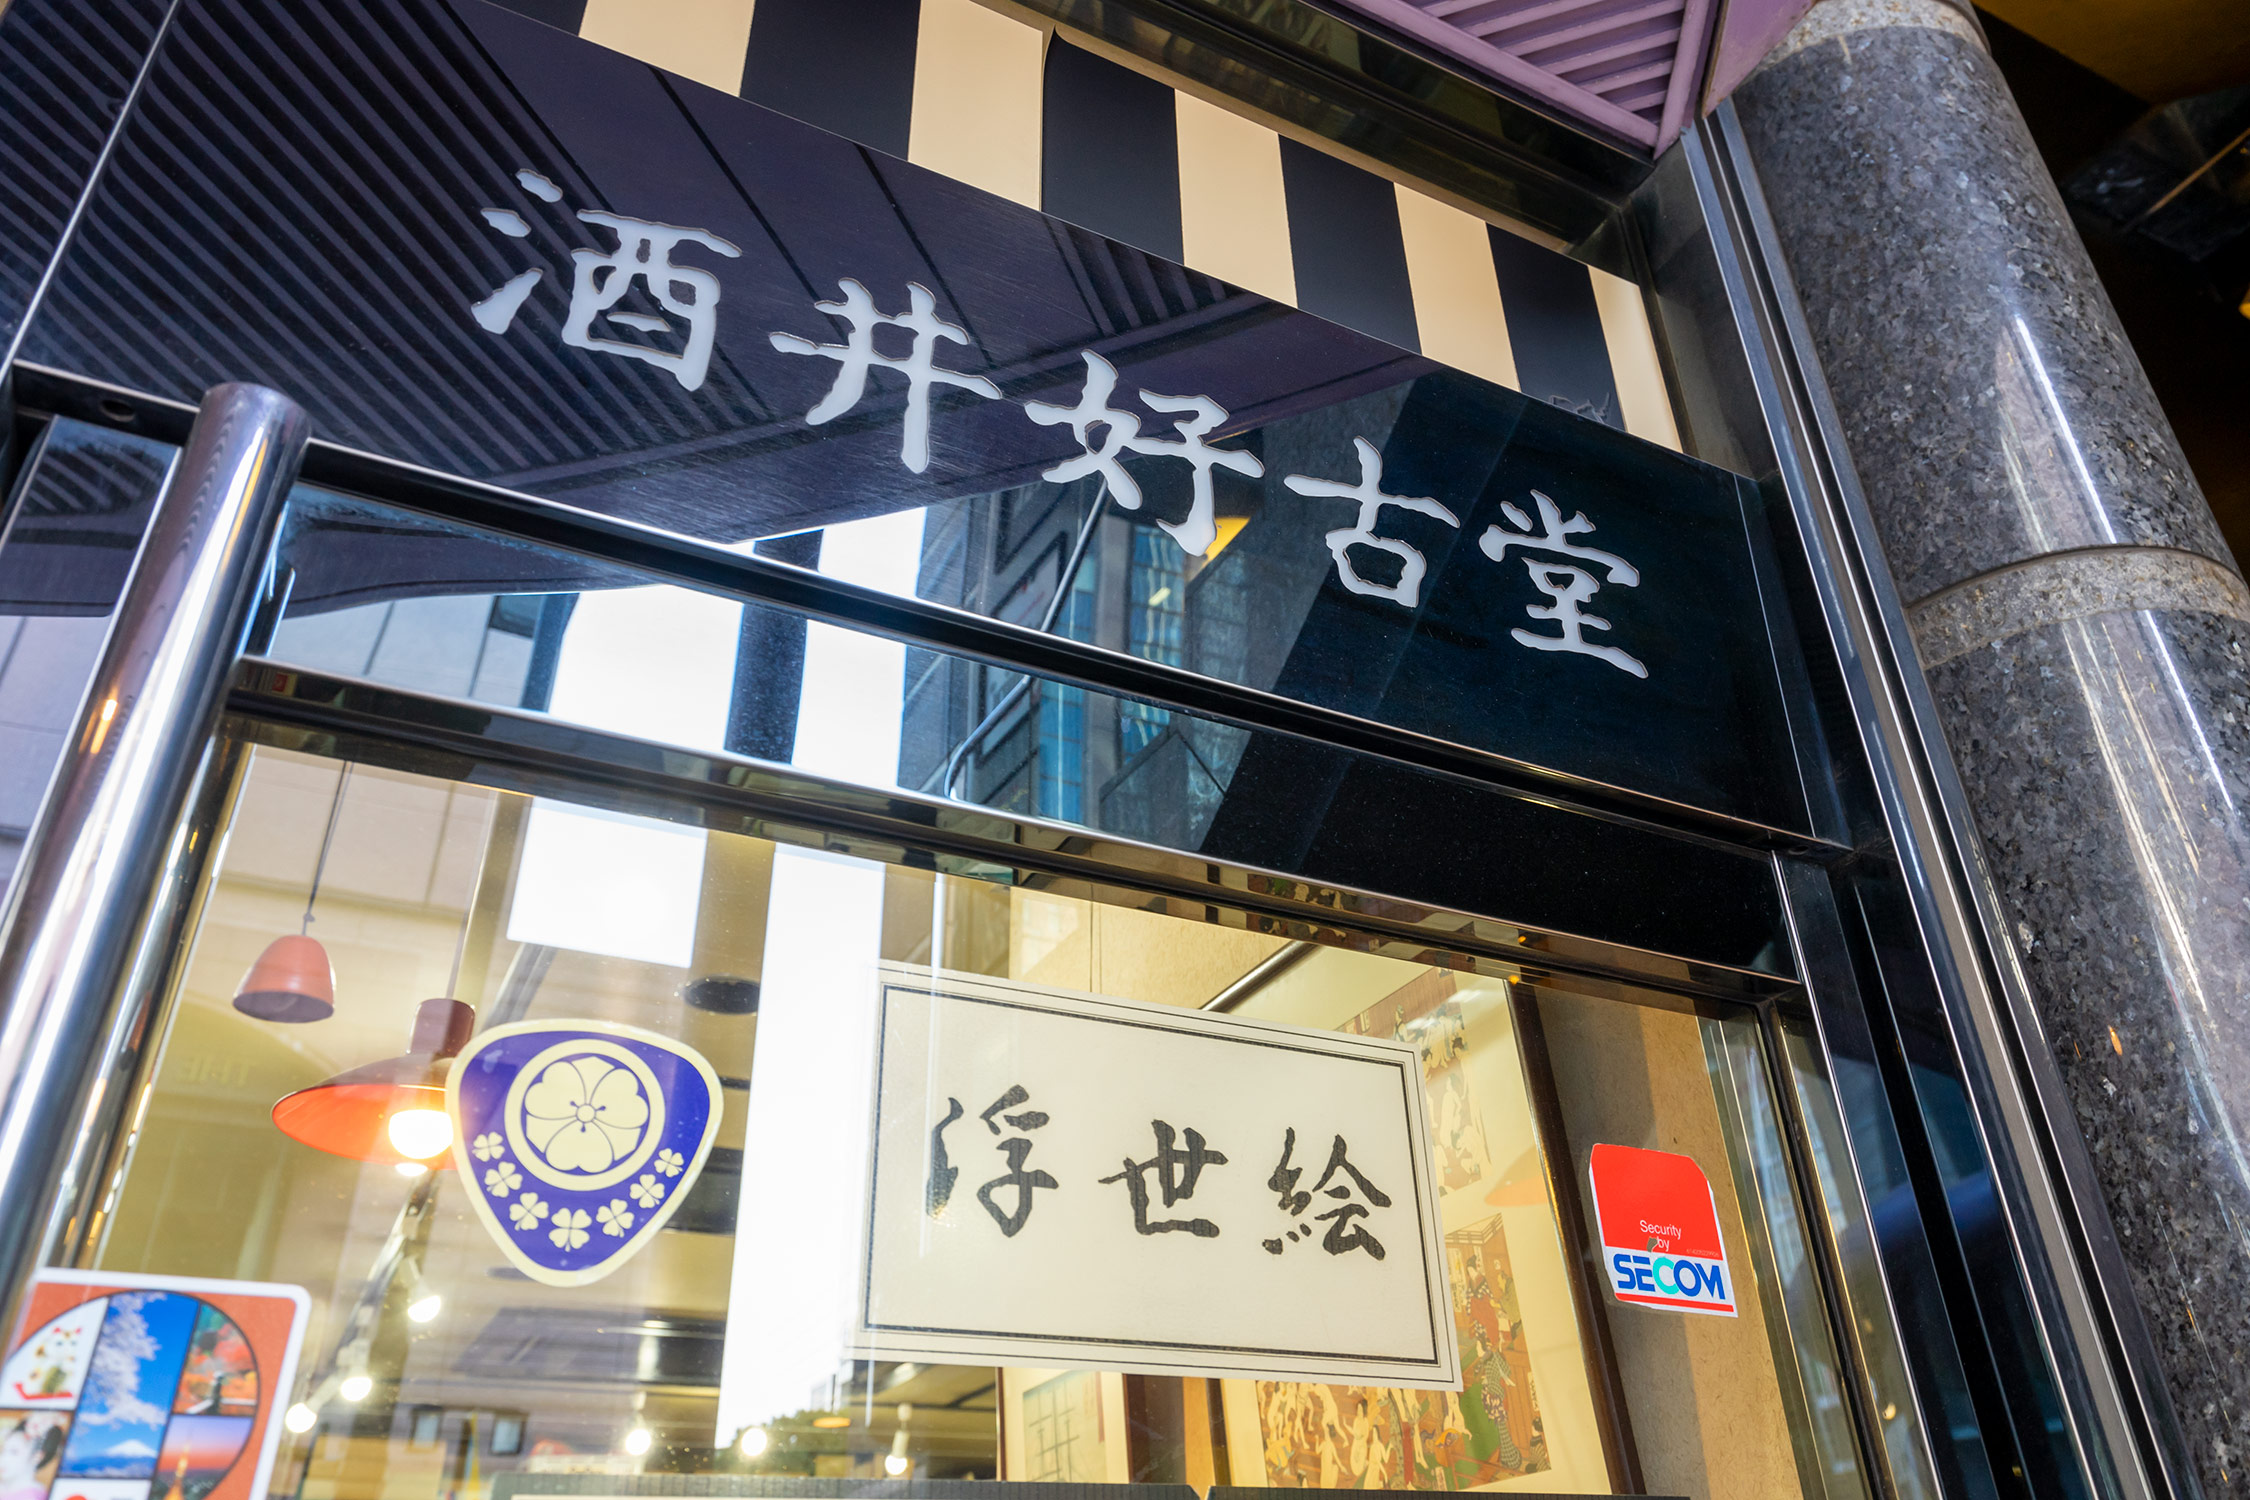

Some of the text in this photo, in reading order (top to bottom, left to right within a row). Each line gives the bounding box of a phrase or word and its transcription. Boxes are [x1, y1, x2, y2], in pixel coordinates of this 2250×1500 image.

[471, 169, 1648, 679] 酒井好古堂
[926, 1084, 1392, 1261] 浮世絵
[1639, 1220, 1682, 1240] Security
[1656, 1236, 1670, 1252] by
[1613, 1253, 1726, 1300] SECOM
